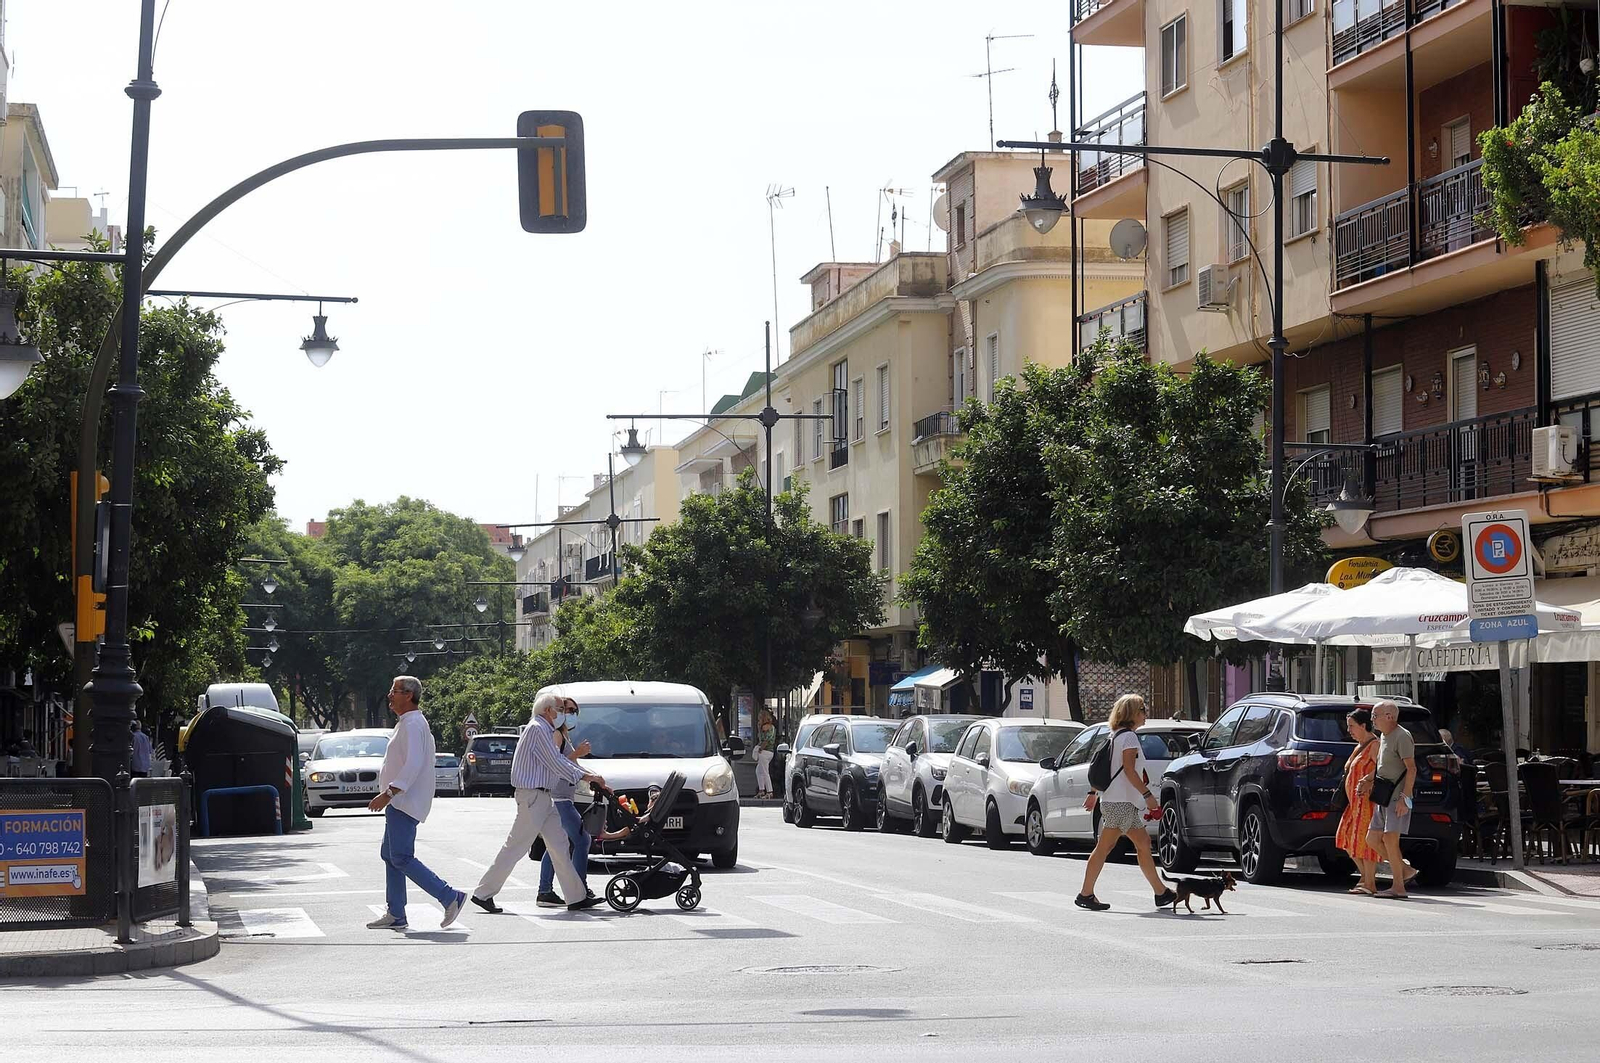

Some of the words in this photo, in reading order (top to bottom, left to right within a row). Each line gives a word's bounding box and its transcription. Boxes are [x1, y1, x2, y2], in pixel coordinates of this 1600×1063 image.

[1340, 572, 1353, 580] Las
[1418, 613, 1468, 622] Cruzcampo
[1480, 621, 1503, 630] ZONA
[1507, 619, 1529, 628] AZUL
[1417, 643, 1492, 668] CAFETERÍA
[5, 816, 82, 834] FORMACIÓN
[16, 842, 37, 855] 640
[39, 842, 59, 855] 798
[61, 841, 81, 854] 742
[10, 868, 70, 880] www.inafe.es
